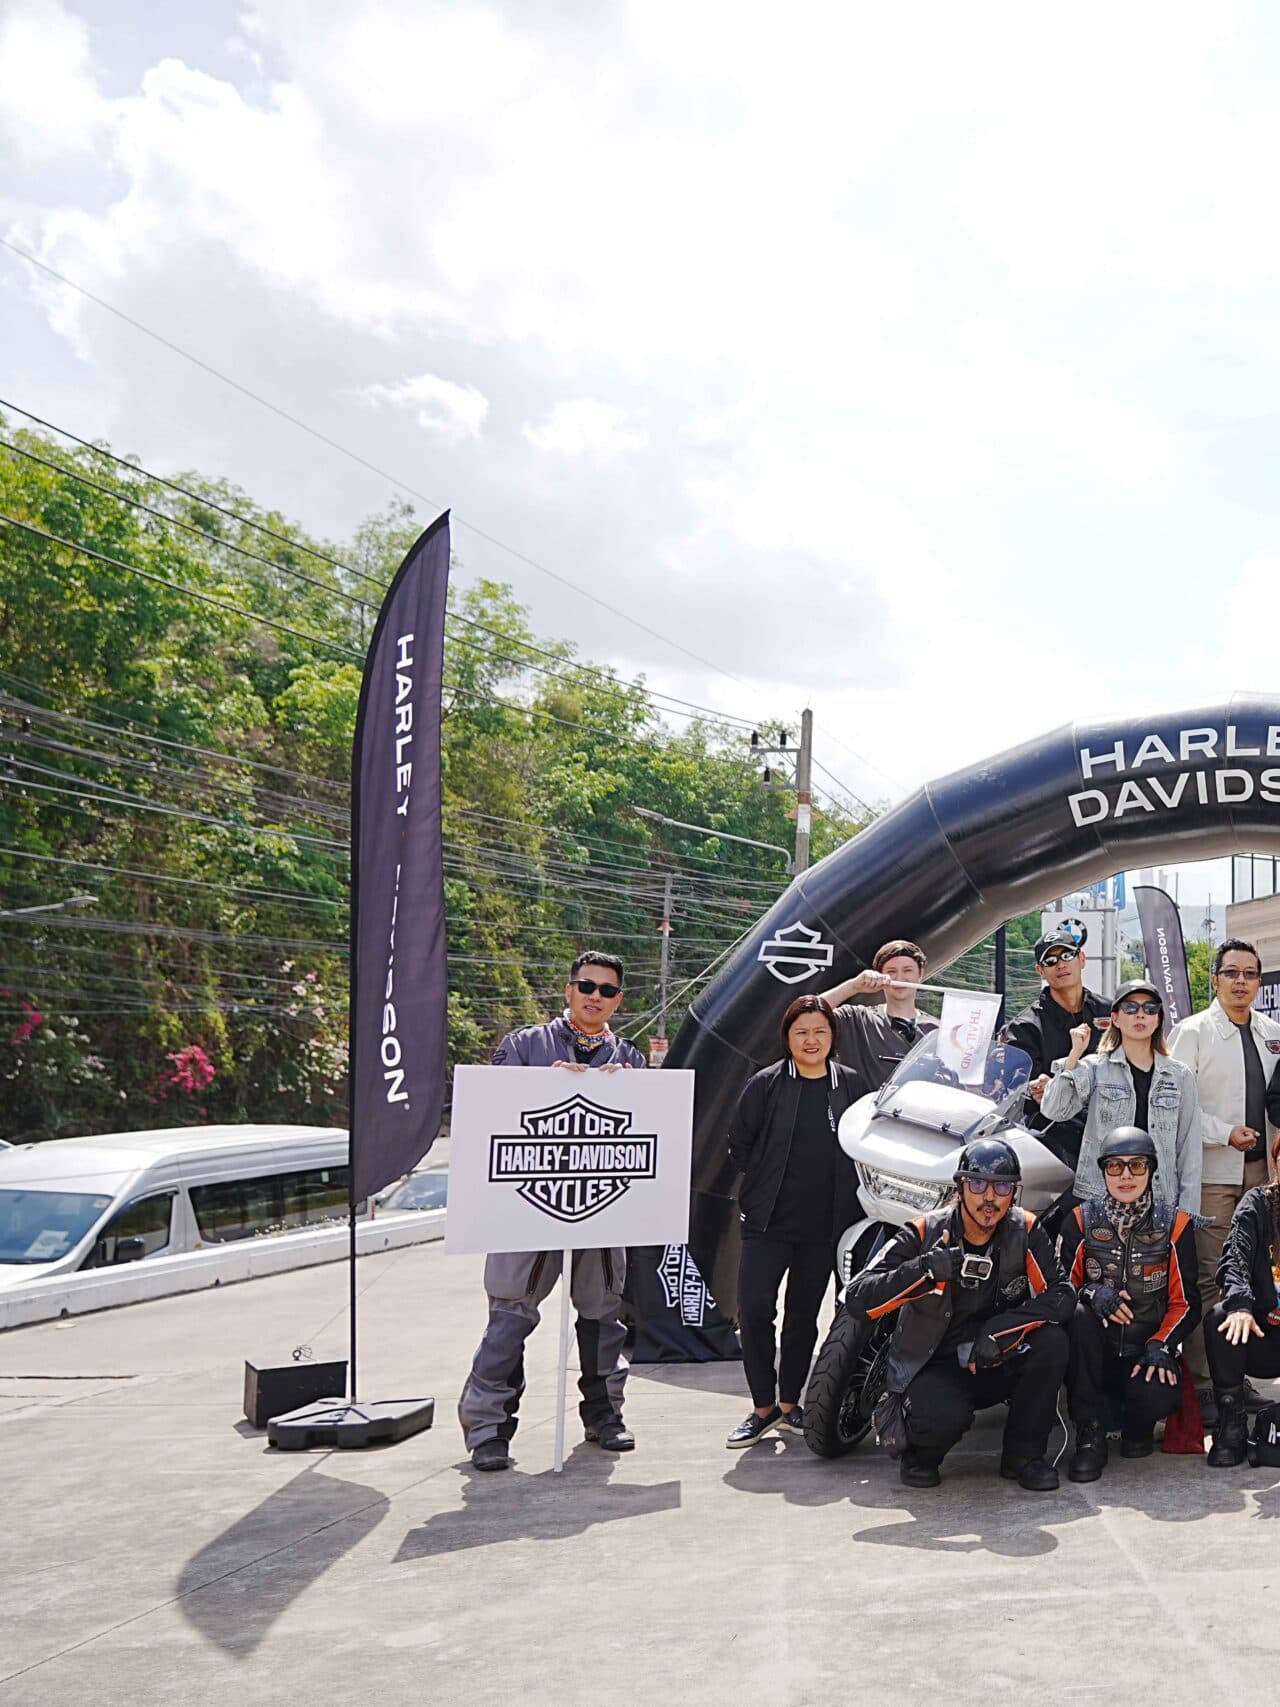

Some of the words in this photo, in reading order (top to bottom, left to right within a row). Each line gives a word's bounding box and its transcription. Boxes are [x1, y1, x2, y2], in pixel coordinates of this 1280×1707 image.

[538, 1106, 615, 1135] MOTOR
[500, 1144, 647, 1172] HARLEY-DAVIDSON
[535, 1179, 613, 1213] CYCLES
[662, 1244, 682, 1297] MOTOR
